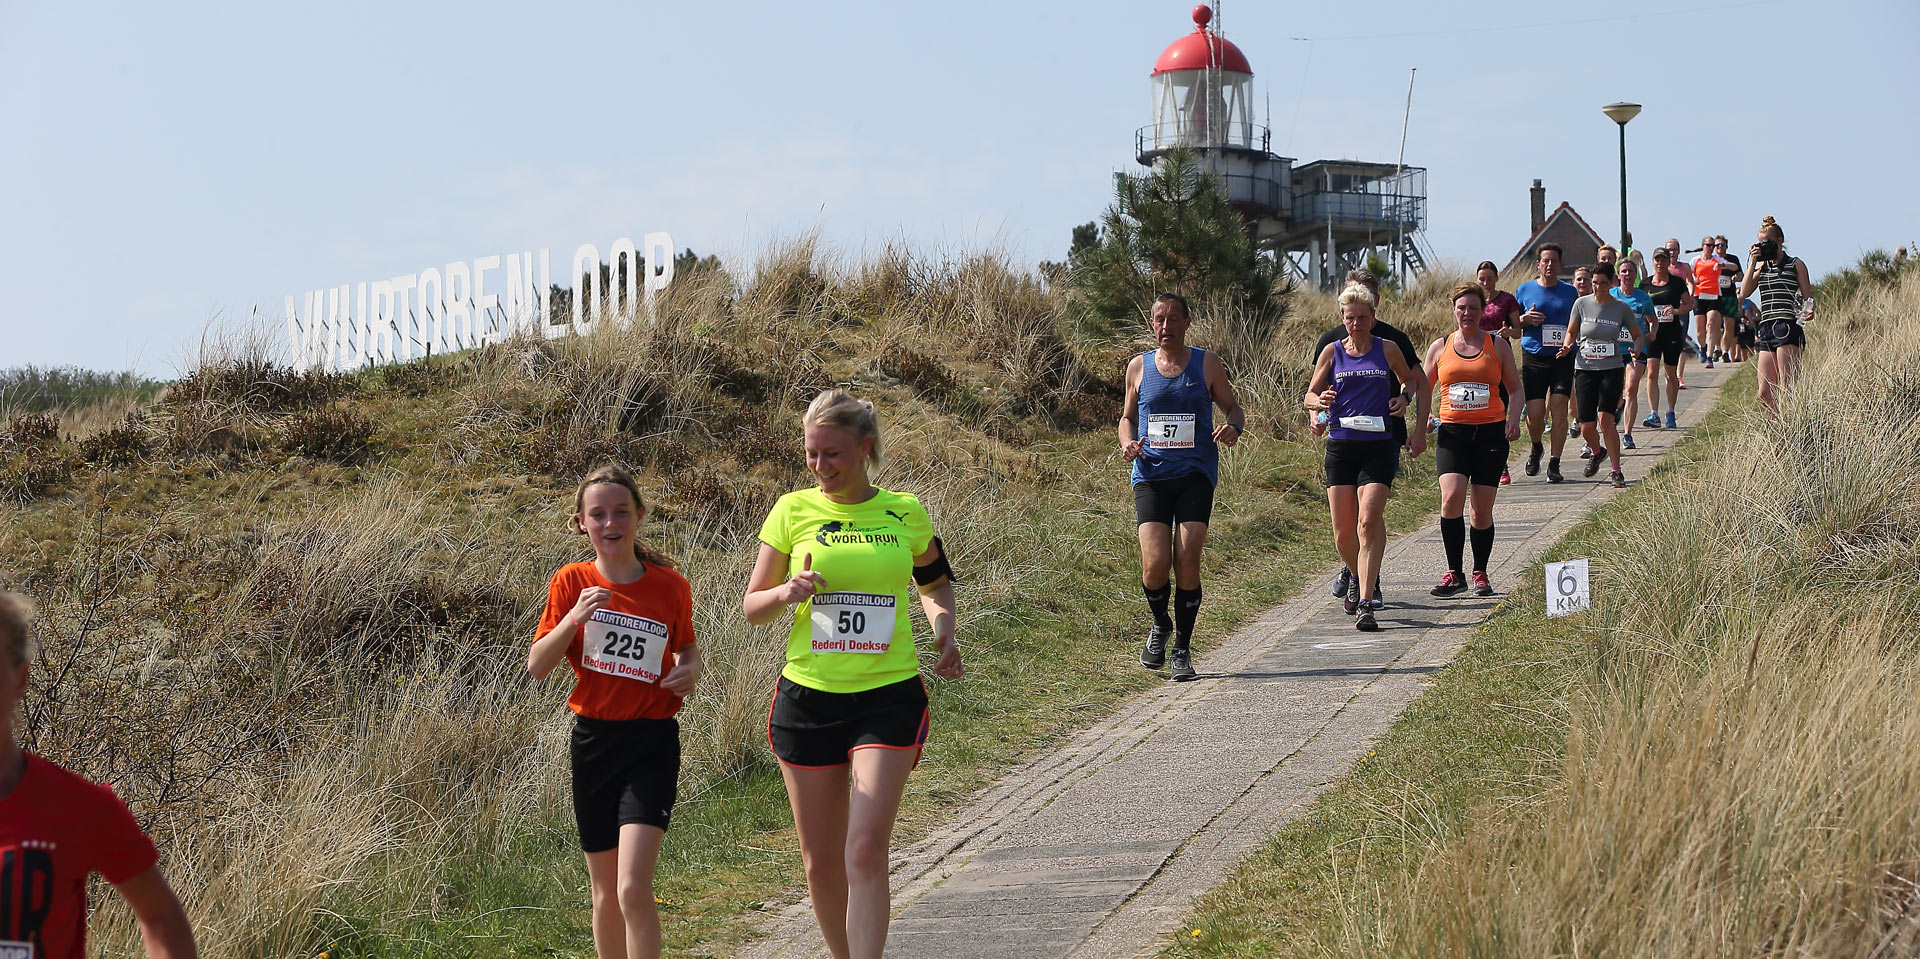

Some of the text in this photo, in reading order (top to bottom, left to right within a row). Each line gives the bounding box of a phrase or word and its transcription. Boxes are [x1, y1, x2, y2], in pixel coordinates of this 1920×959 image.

[285, 231, 674, 377] VUURTORENLOOP
[1552, 331, 1562, 341] 56
[1591, 345, 1607, 353] 355
[1463, 389, 1475, 401] 21
[1163, 424, 1178, 438] 57
[831, 534, 873, 544] WORLD
[874, 534, 899, 545] RUN
[1557, 565, 1577, 597] 6
[815, 593, 894, 607] VUURTORENLOOP
[1556, 596, 1581, 610] KM
[838, 610, 866, 635] 50
[602, 630, 647, 661] 225
[811, 639, 846, 652] Rederij
[583, 654, 616, 674] Rederij
